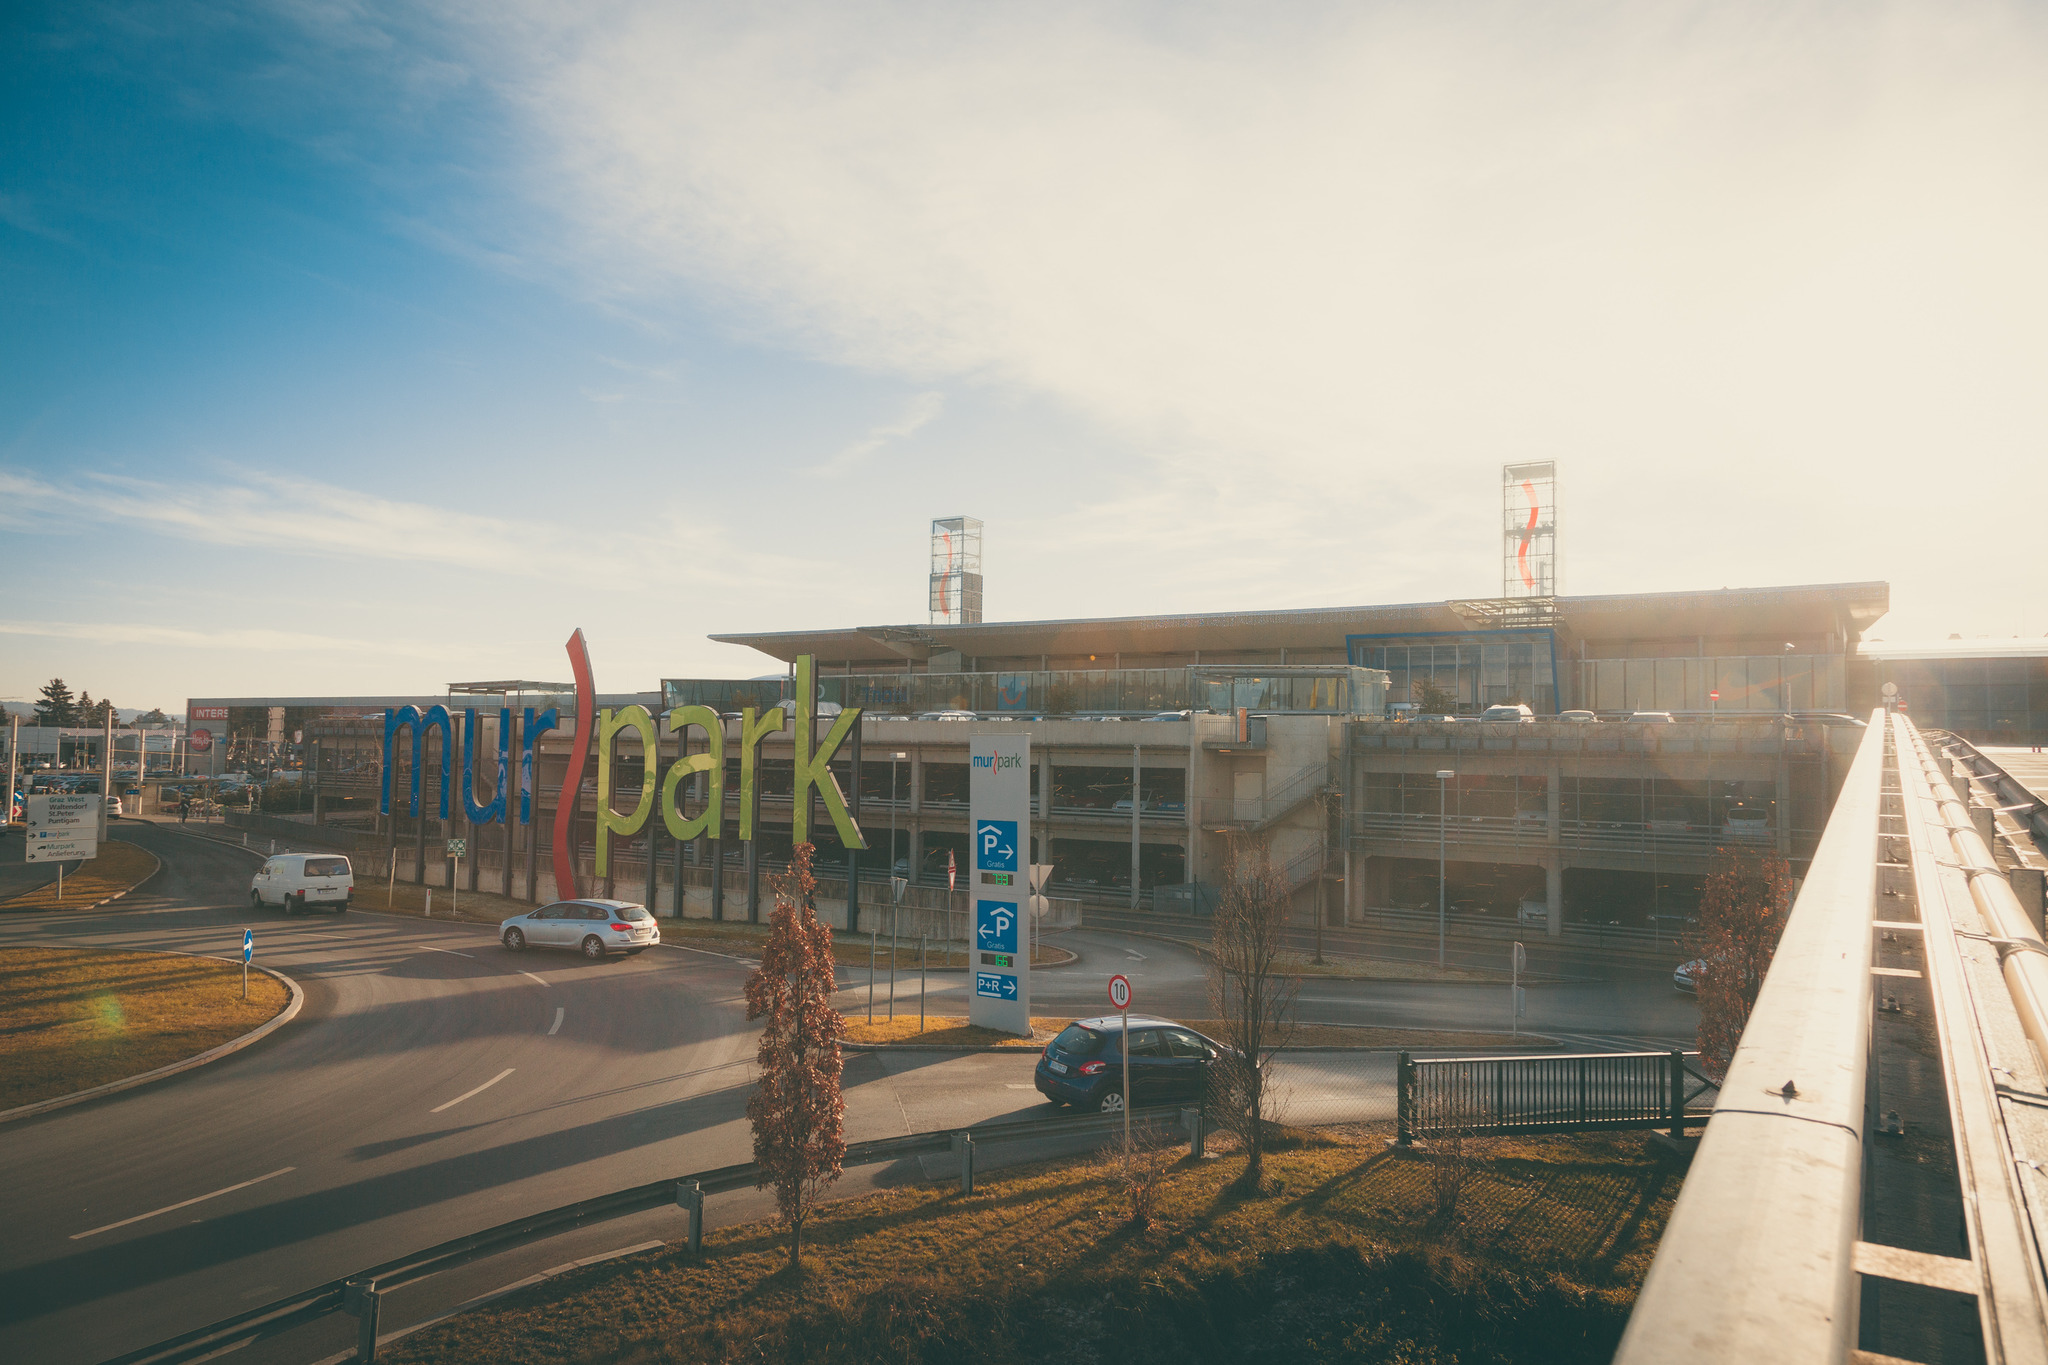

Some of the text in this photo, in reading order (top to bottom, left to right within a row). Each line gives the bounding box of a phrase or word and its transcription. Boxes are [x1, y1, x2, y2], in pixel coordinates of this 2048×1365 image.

[196, 709, 229, 718] INTERS
[381, 654, 868, 878] mur park
[997, 753, 1022, 771] park
[48, 817, 80, 825] Puntigam
[984, 834, 998, 855] P
[986, 860, 1005, 869] Gratis
[996, 916, 1010, 937] P
[986, 941, 1005, 950] Gratis
[978, 978, 1000, 992] P+R
[1114, 983, 1125, 1001] 10
